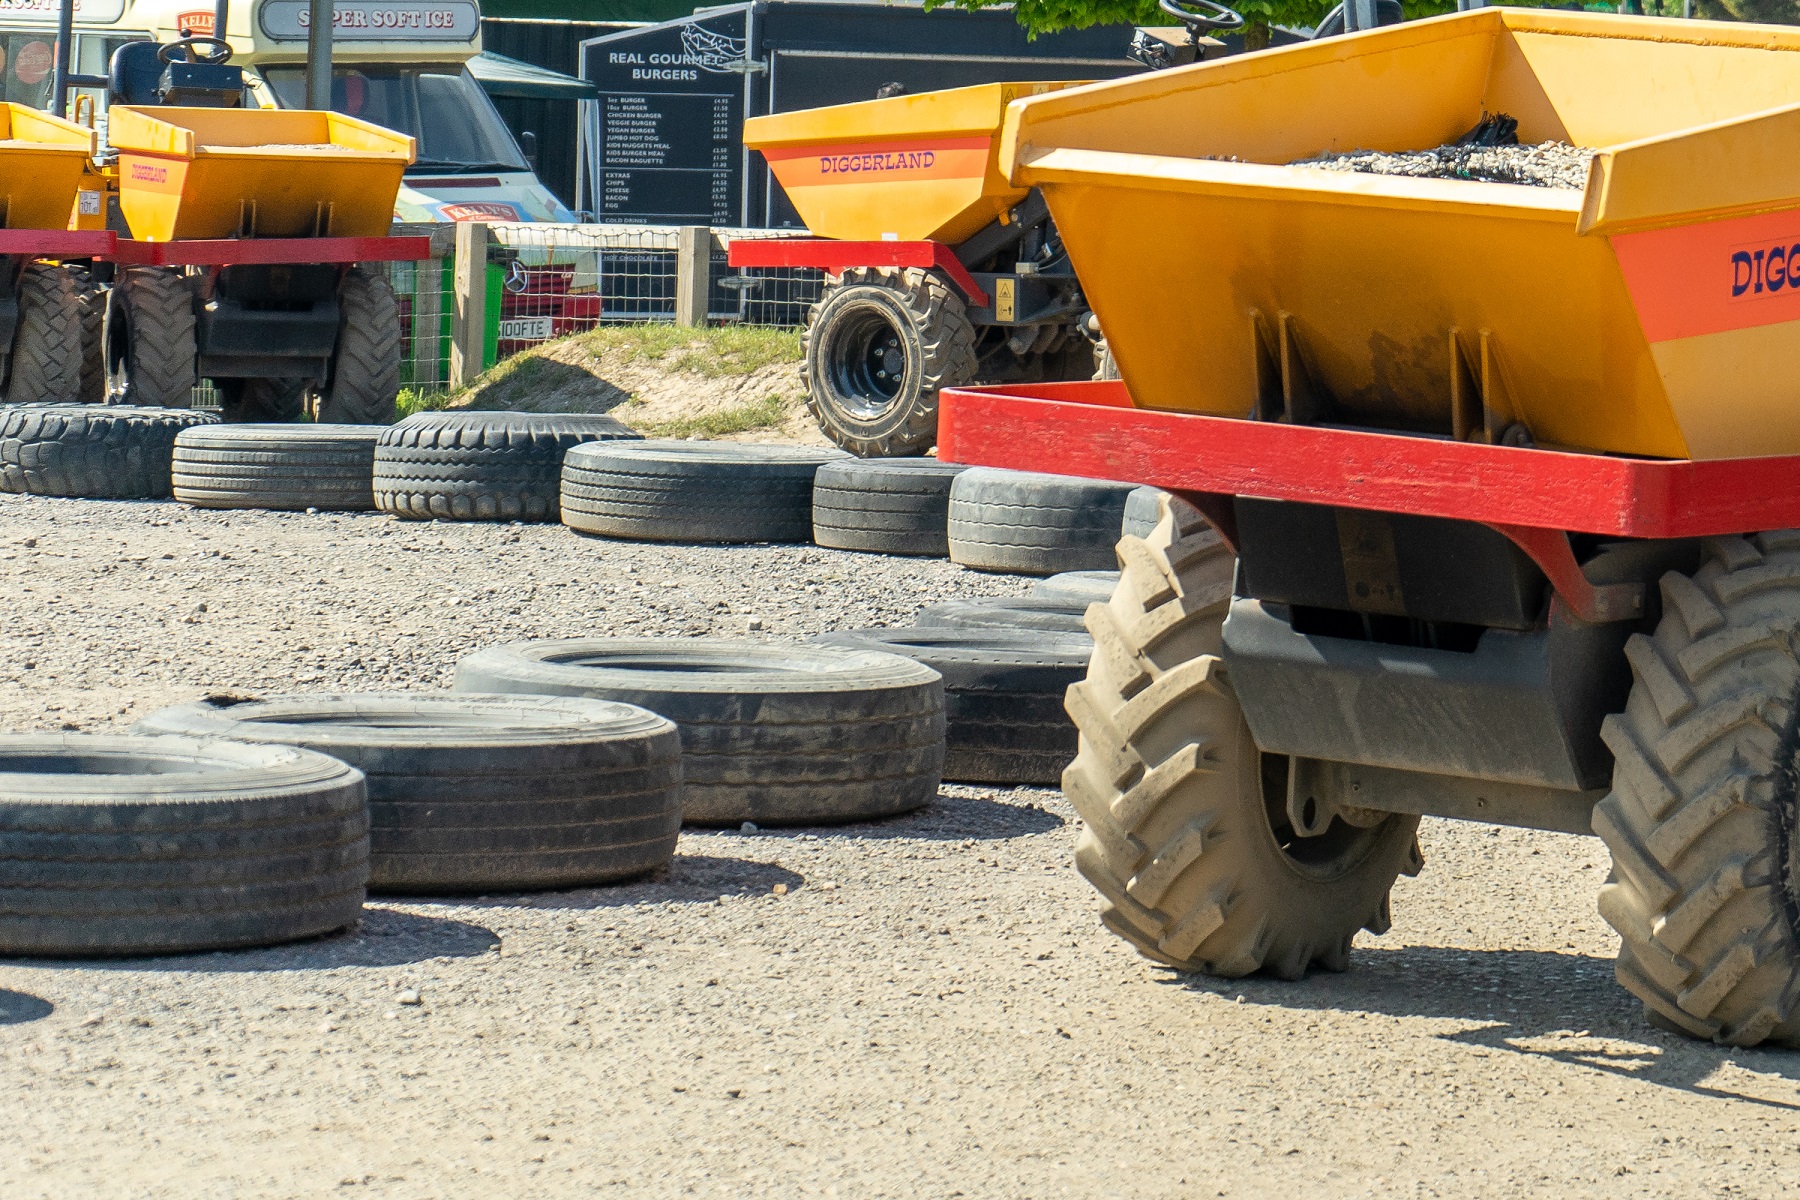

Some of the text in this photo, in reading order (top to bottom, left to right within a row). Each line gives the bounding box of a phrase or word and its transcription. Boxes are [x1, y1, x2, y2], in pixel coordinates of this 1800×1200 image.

[180, 15, 215, 28] KELLY
[297, 9, 454, 28] SPER SOFT ICE
[609, 52, 719, 66] REAL GOURMET
[632, 68, 698, 80] BURGERS
[820, 151, 935, 173] DIGGERLAND
[449, 204, 513, 218] KELLY'S
[498, 321, 543, 336] 100FTE
